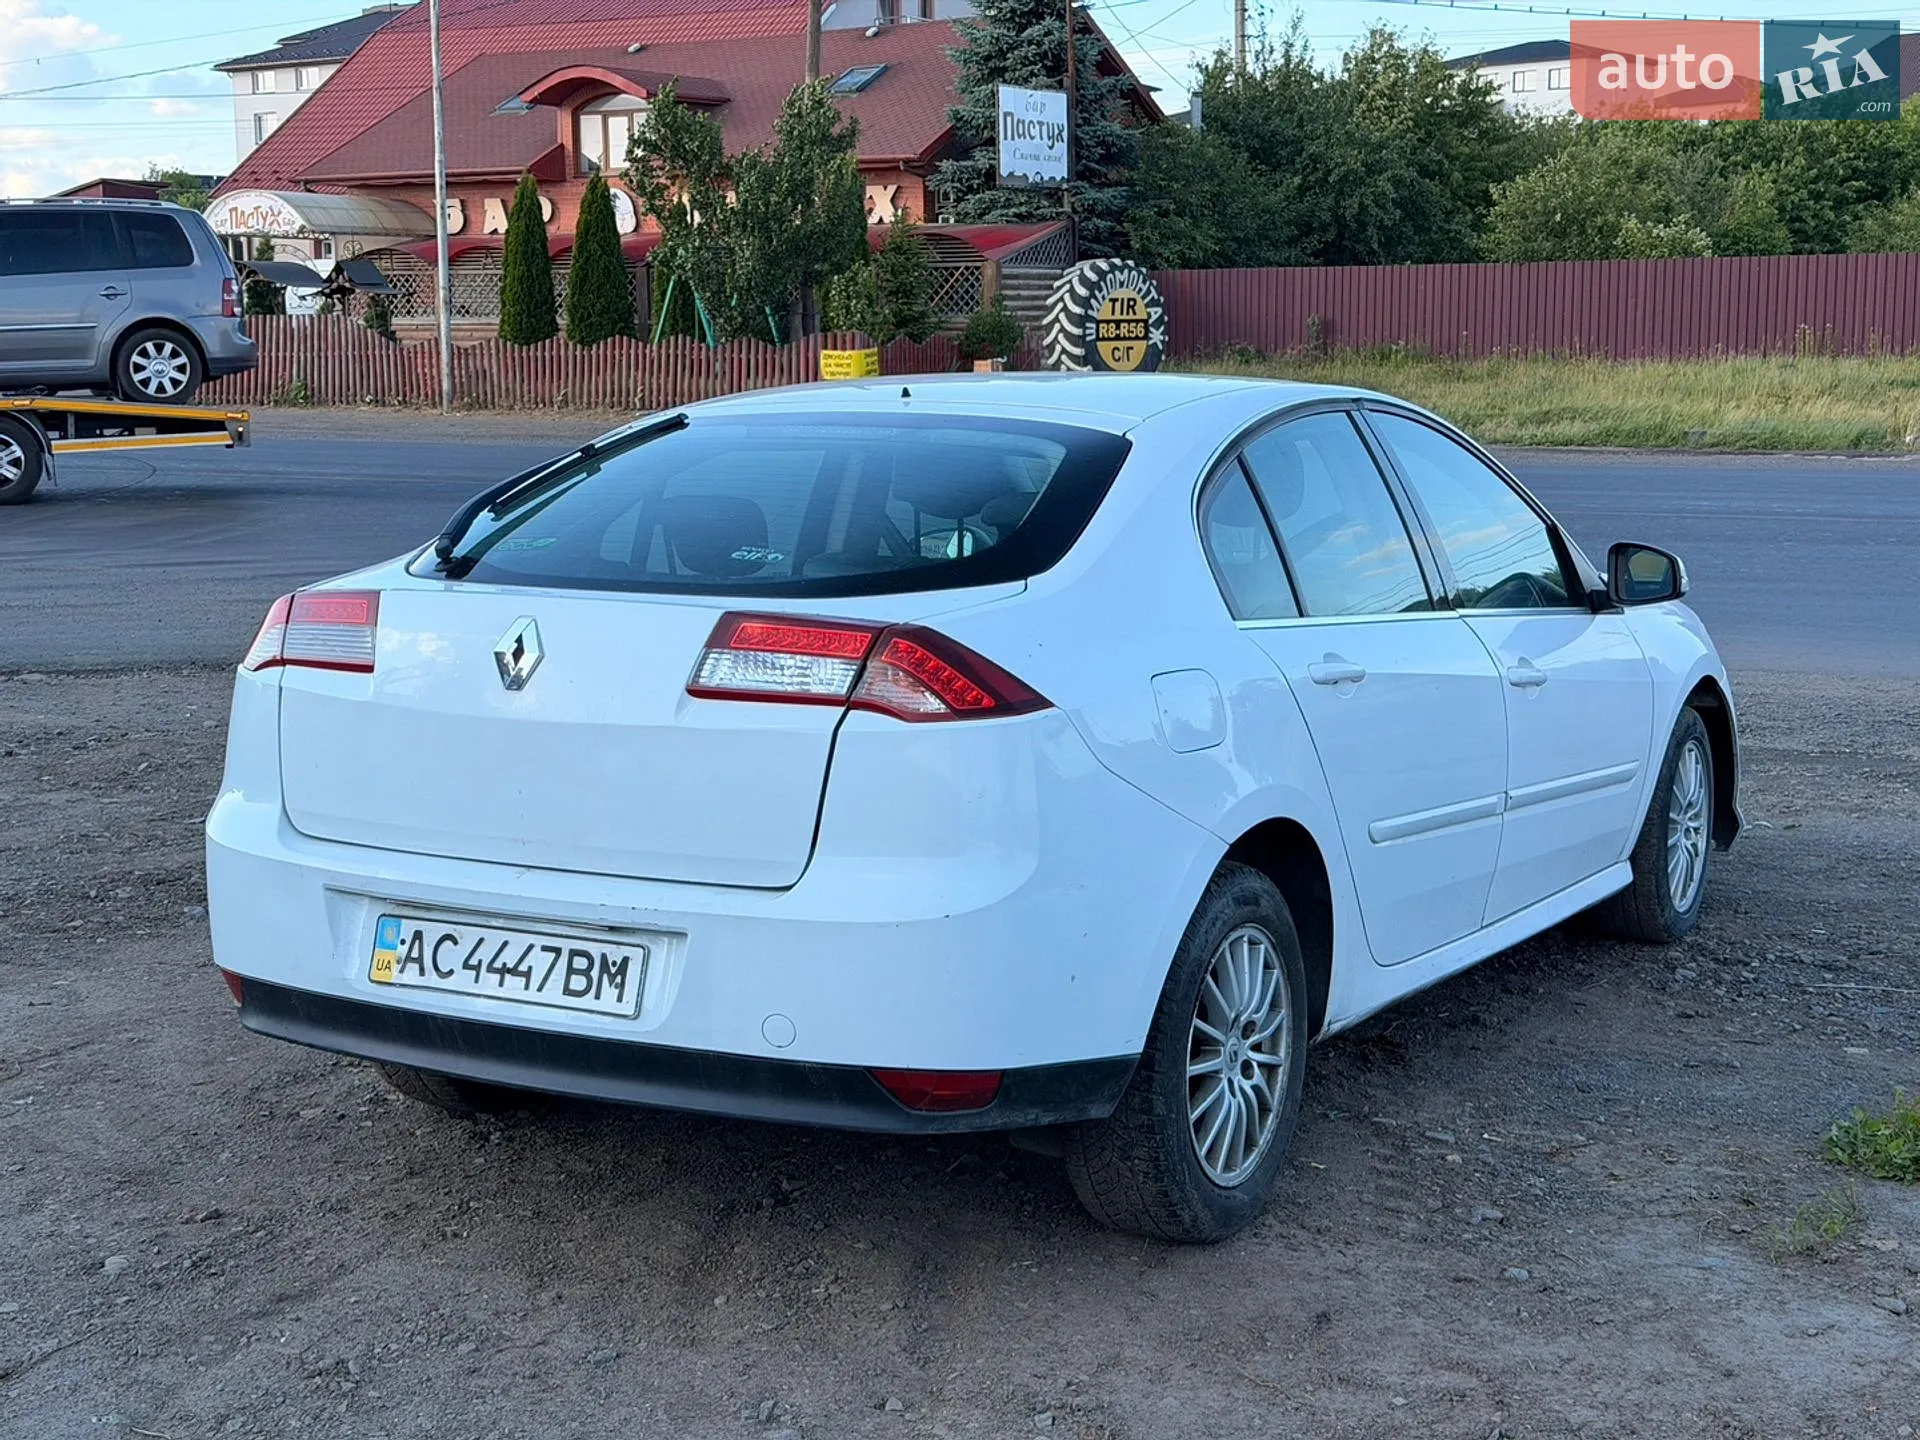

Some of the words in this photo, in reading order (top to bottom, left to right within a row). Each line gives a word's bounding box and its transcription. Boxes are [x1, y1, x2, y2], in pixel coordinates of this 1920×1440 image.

[1003, 111, 1065, 150] Пастух
[1085, 268, 1164, 350] ШИНОМОНТАЖ
[1109, 297, 1137, 316] TIR
[1098, 322, 1146, 339] R8-R56
[375, 957, 392, 973] UA
